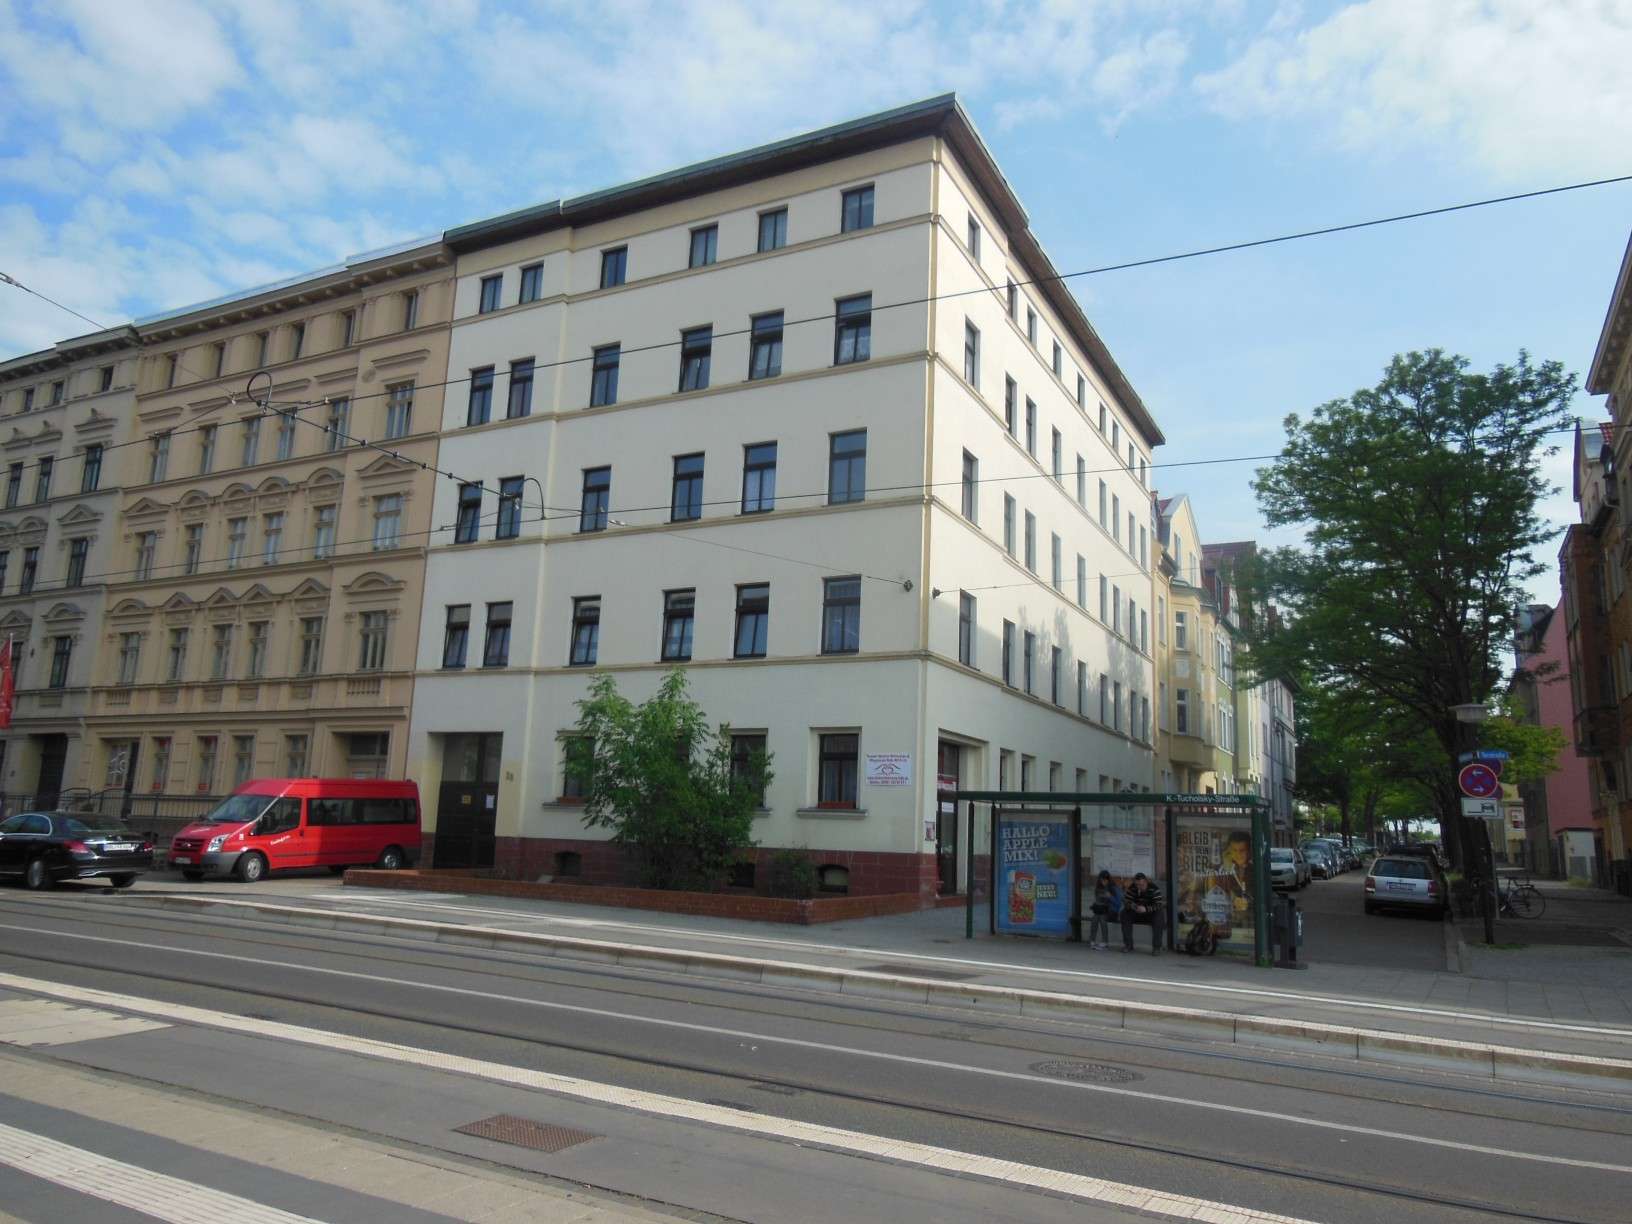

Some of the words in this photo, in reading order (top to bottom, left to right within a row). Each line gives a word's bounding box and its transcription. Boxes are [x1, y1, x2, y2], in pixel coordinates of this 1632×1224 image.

[1002, 825, 1050, 839] HALLO
[1182, 831, 1209, 845] BLEIB
[1003, 838, 1048, 850] APPLE
[1004, 849, 1039, 862] MIX!
